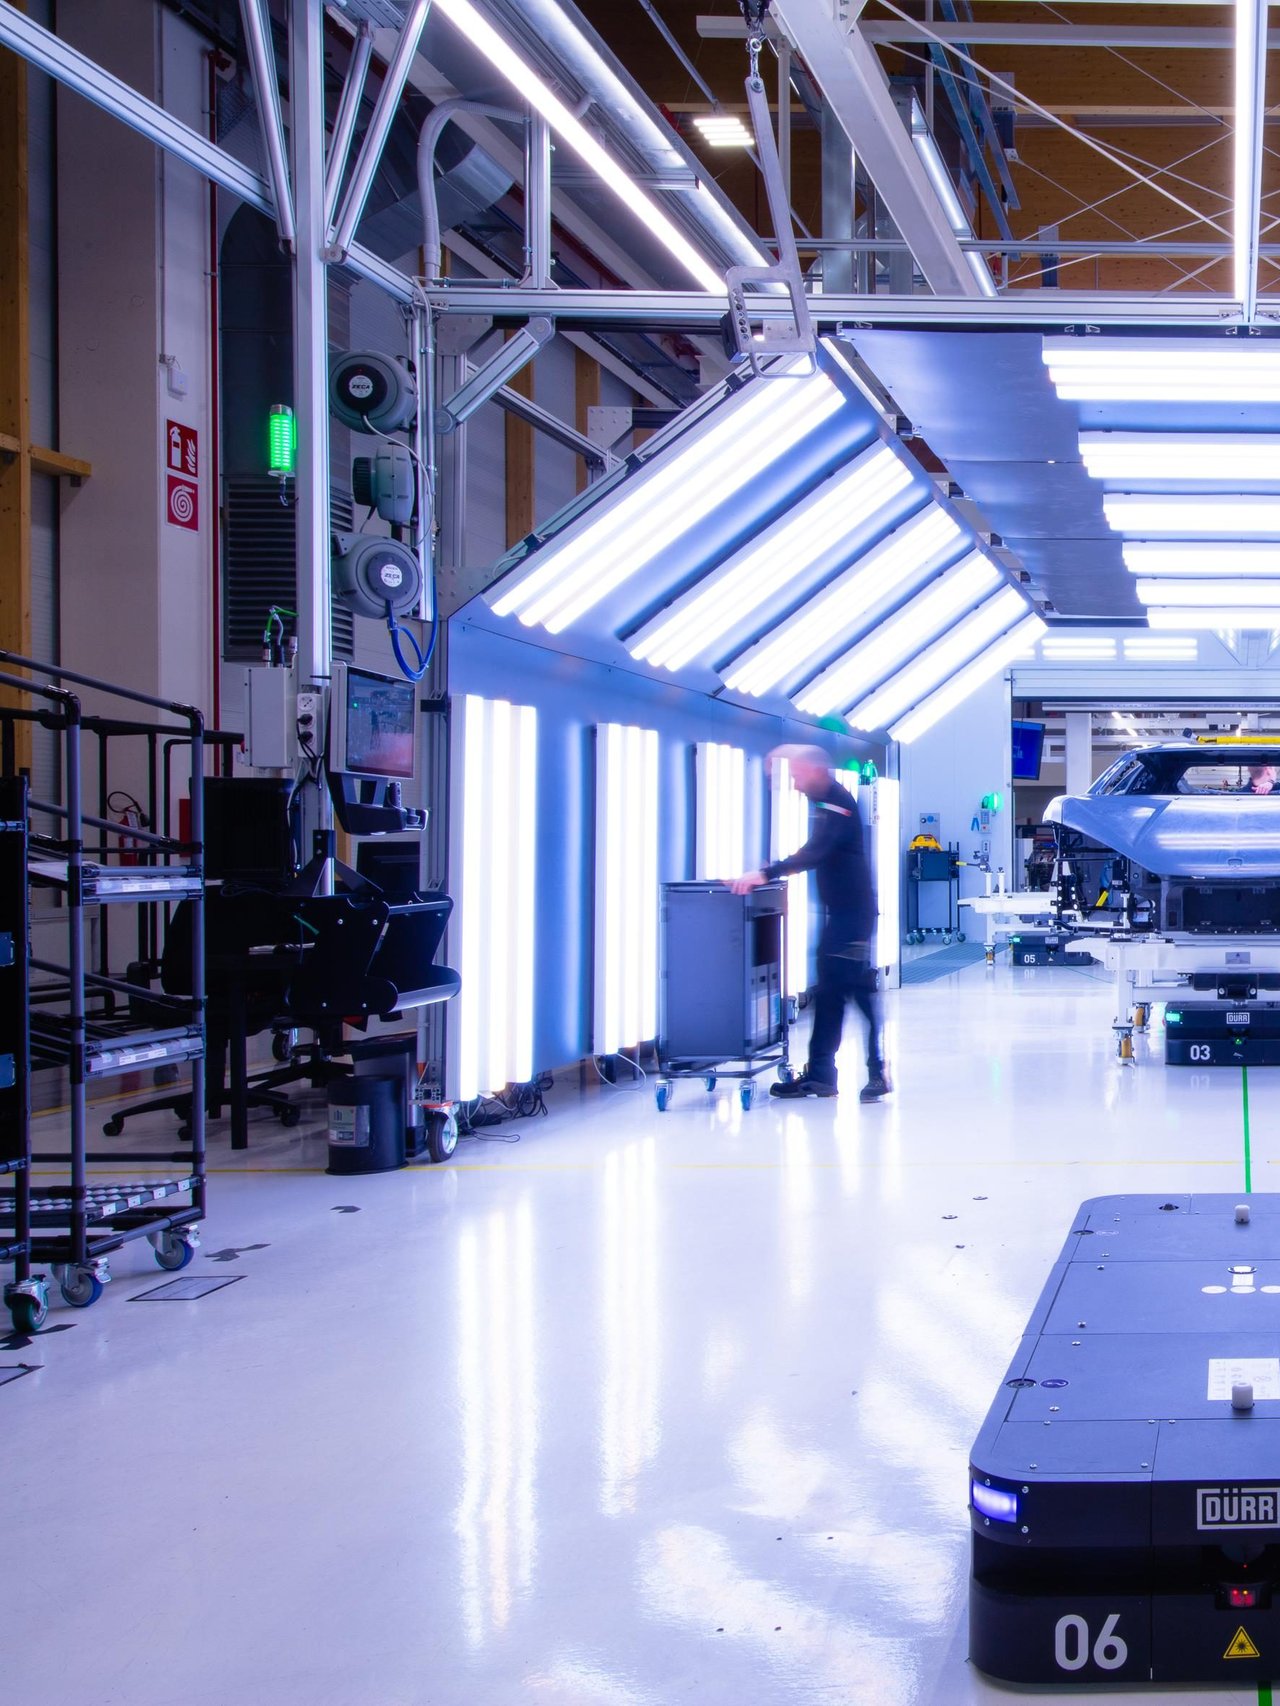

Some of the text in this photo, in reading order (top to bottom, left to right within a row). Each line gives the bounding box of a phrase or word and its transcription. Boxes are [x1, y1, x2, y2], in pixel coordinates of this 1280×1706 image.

[1024, 954, 1036, 964] 05
[1228, 1012, 1248, 1022] DÜRR
[1190, 1045, 1211, 1061] 03
[1206, 1488, 1274, 1522] DÜRR
[1055, 1614, 1128, 1671] 06
